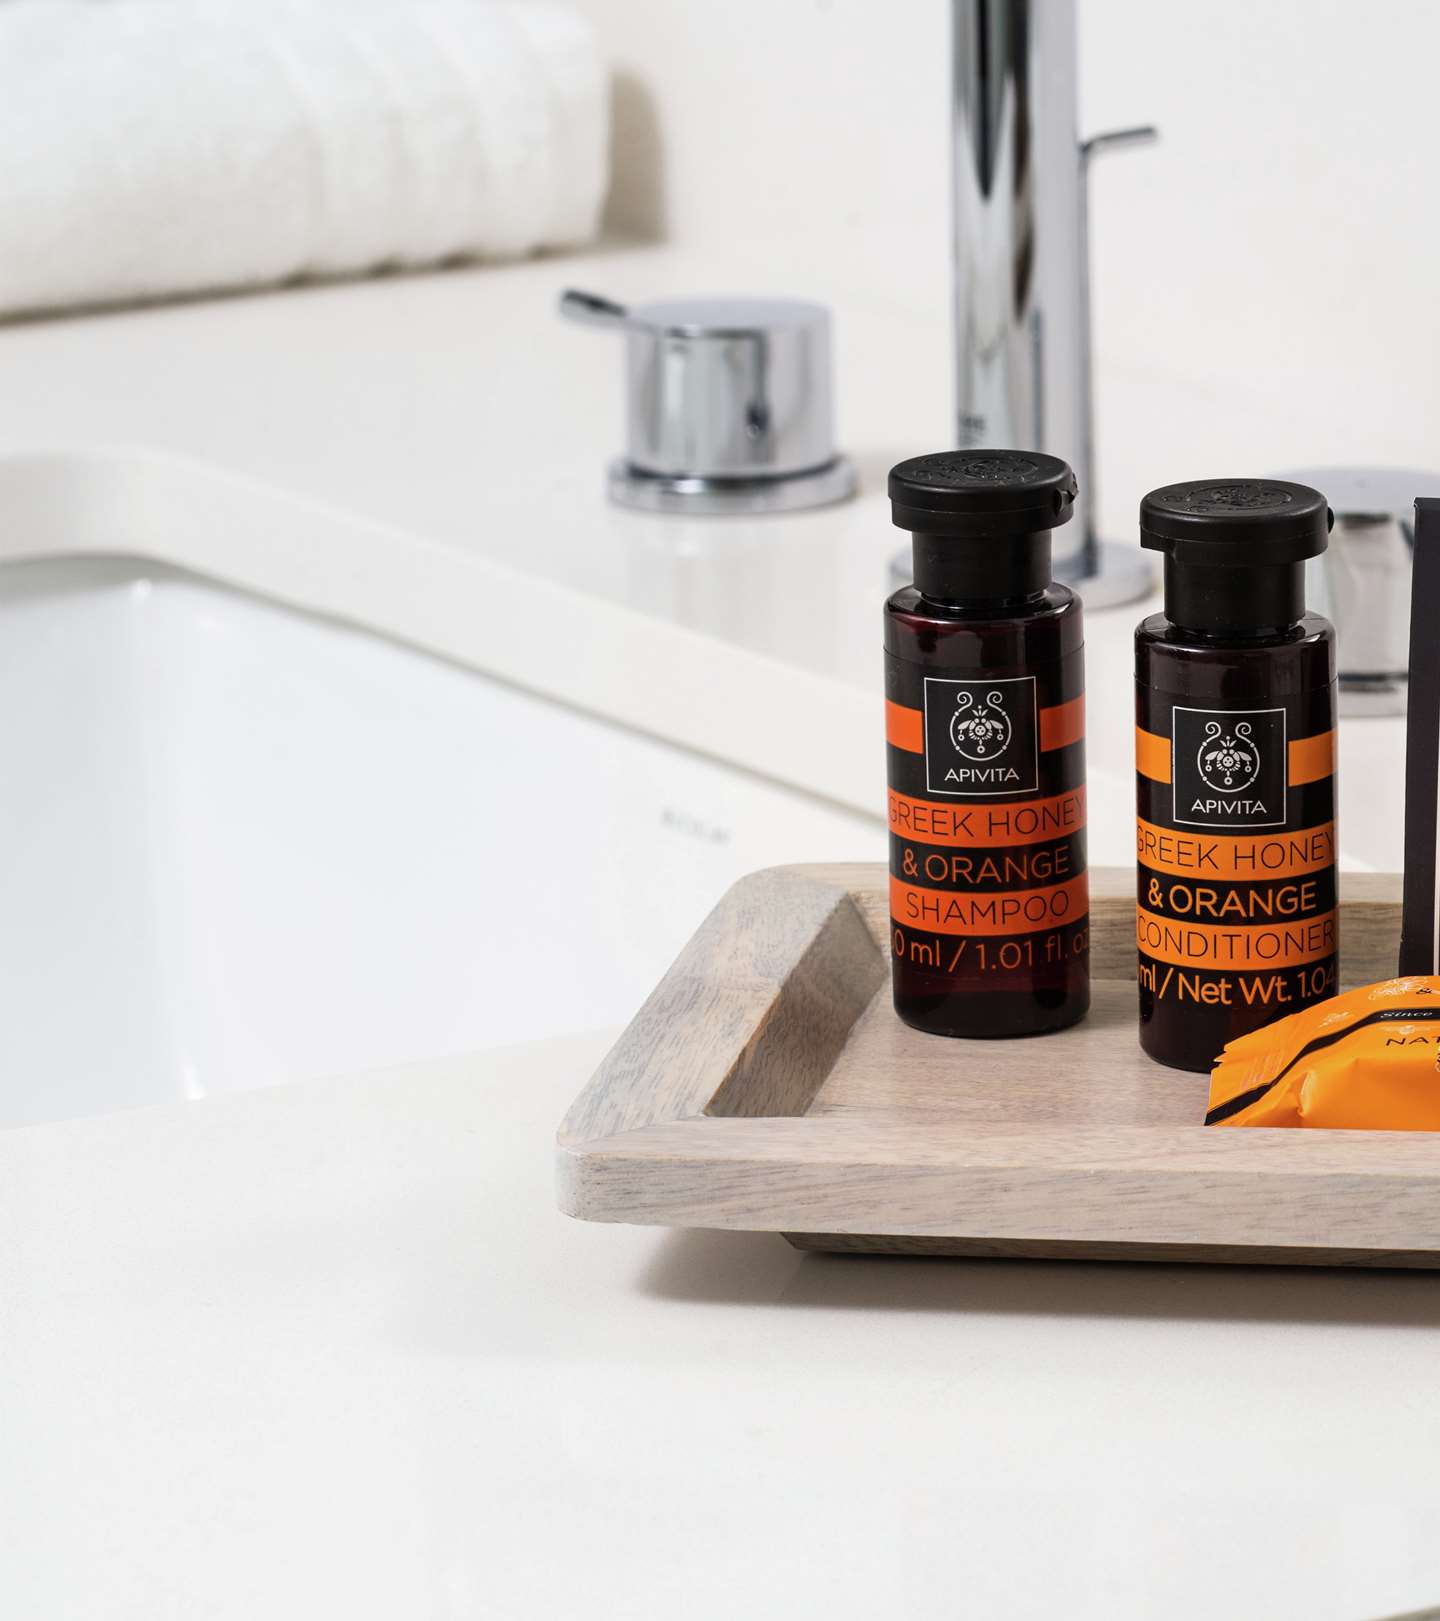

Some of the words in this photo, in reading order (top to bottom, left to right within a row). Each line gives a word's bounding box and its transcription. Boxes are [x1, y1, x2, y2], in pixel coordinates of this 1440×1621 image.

[944, 767, 1020, 782] APIVITA
[889, 796, 974, 837] GREEK
[1191, 799, 1267, 814] APIVITA
[903, 848, 918, 877] &
[924, 845, 1070, 884] ORANGE
[1137, 826, 1219, 870] GREEK
[906, 891, 1069, 926] SHAMPOO
[1148, 878, 1163, 908] &
[1169, 881, 1317, 919] ORANGE
[911, 939, 940, 967] ml
[976, 940, 1033, 970] 1.01
[1045, 933, 1069, 963] fl.
[1138, 915, 1334, 960] CONDITIONER
[1239, 975, 1293, 1005] Wt.
[1380, 1011, 1433, 1019] Since
